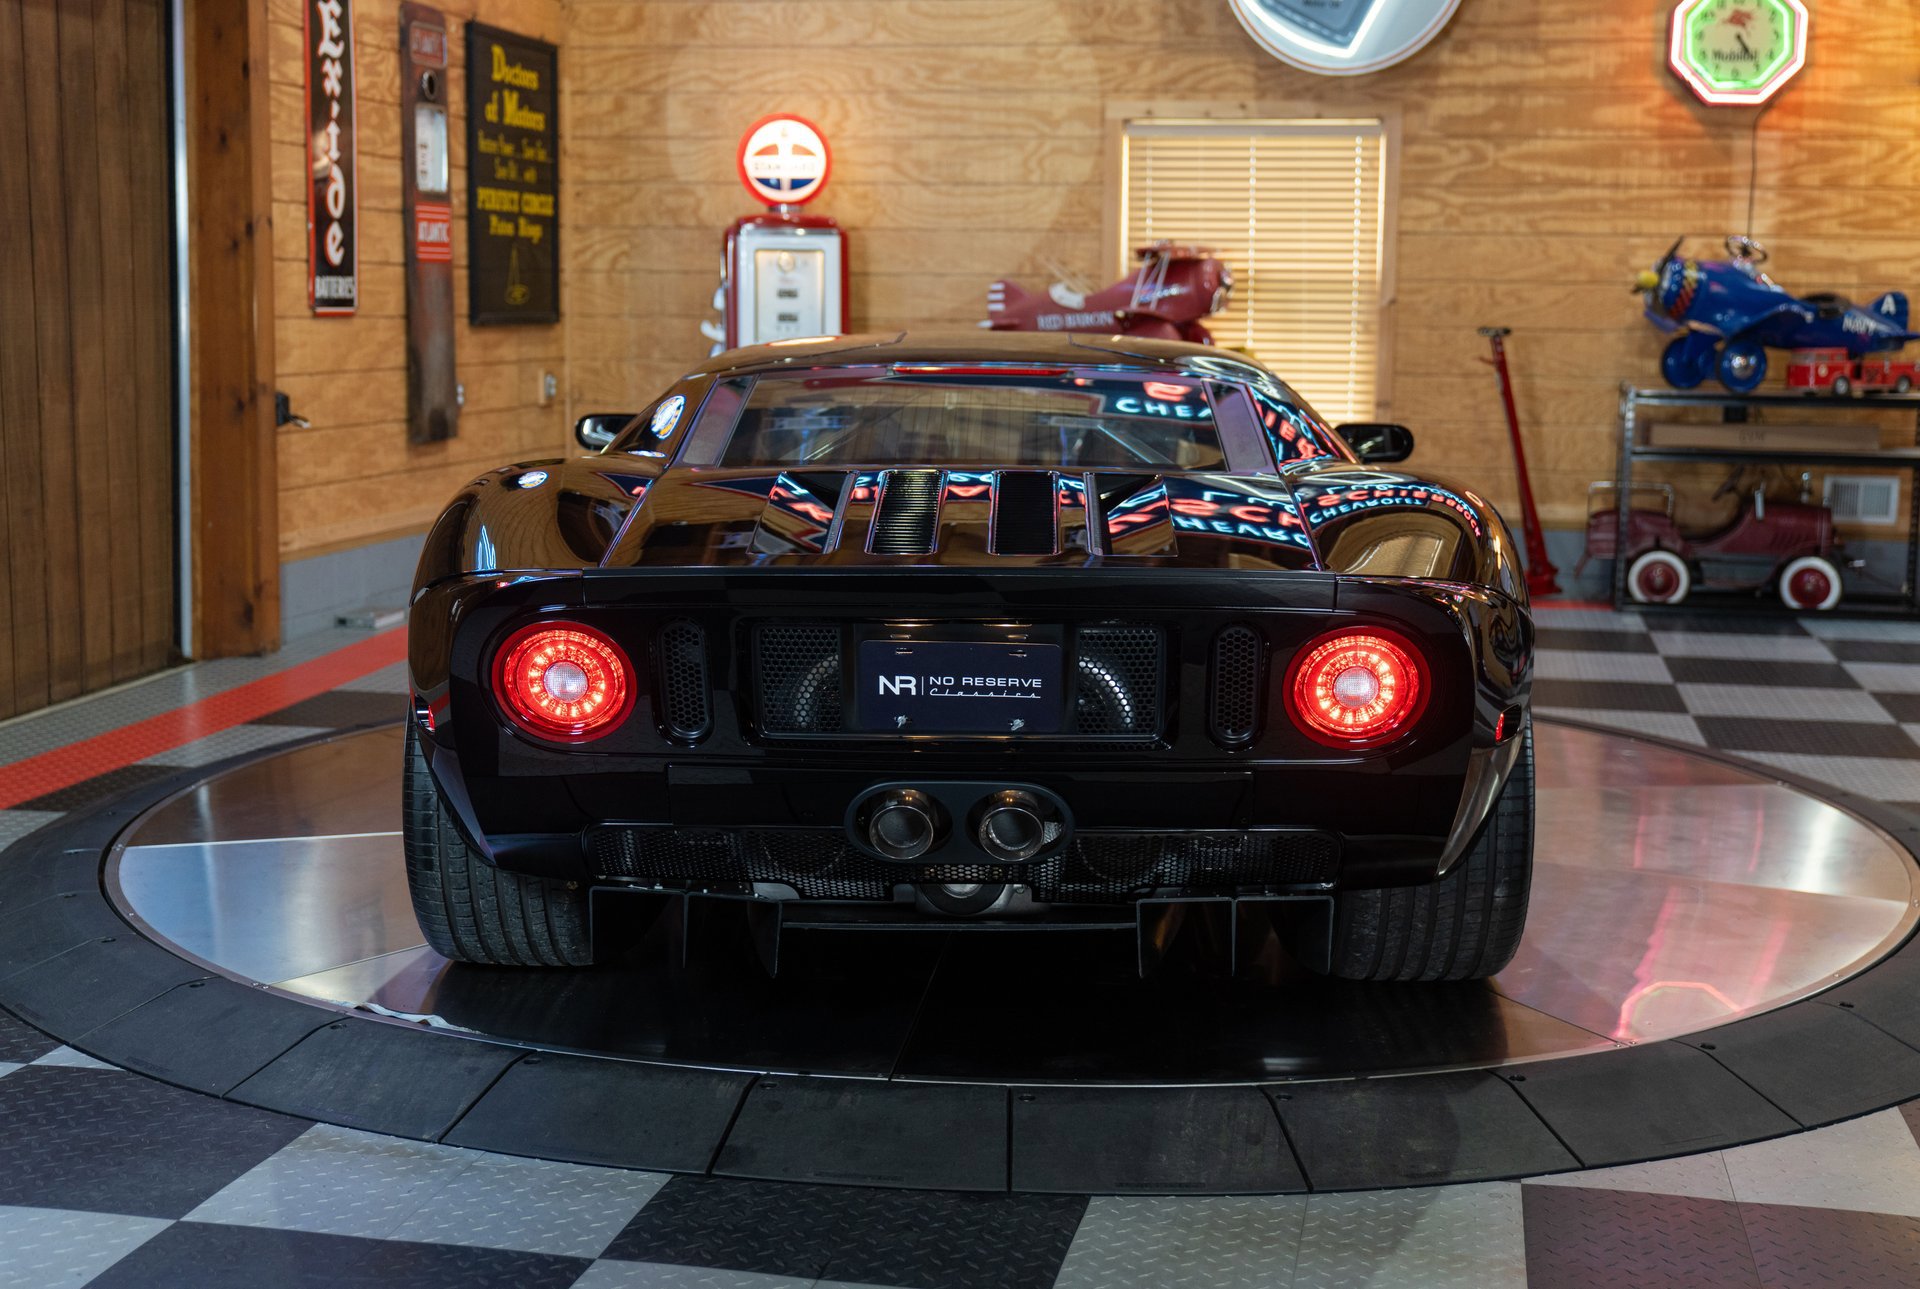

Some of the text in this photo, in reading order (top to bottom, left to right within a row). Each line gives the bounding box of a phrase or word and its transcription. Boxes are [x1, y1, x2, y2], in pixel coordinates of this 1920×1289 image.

[492, 45, 538, 90] Doctors
[1880, 293, 1897, 316] A
[1842, 315, 1877, 336] NAVY
[878, 675, 917, 696] NR
[929, 676, 1042, 688] NO RESERVE
[929, 687, 1041, 699] Classics
